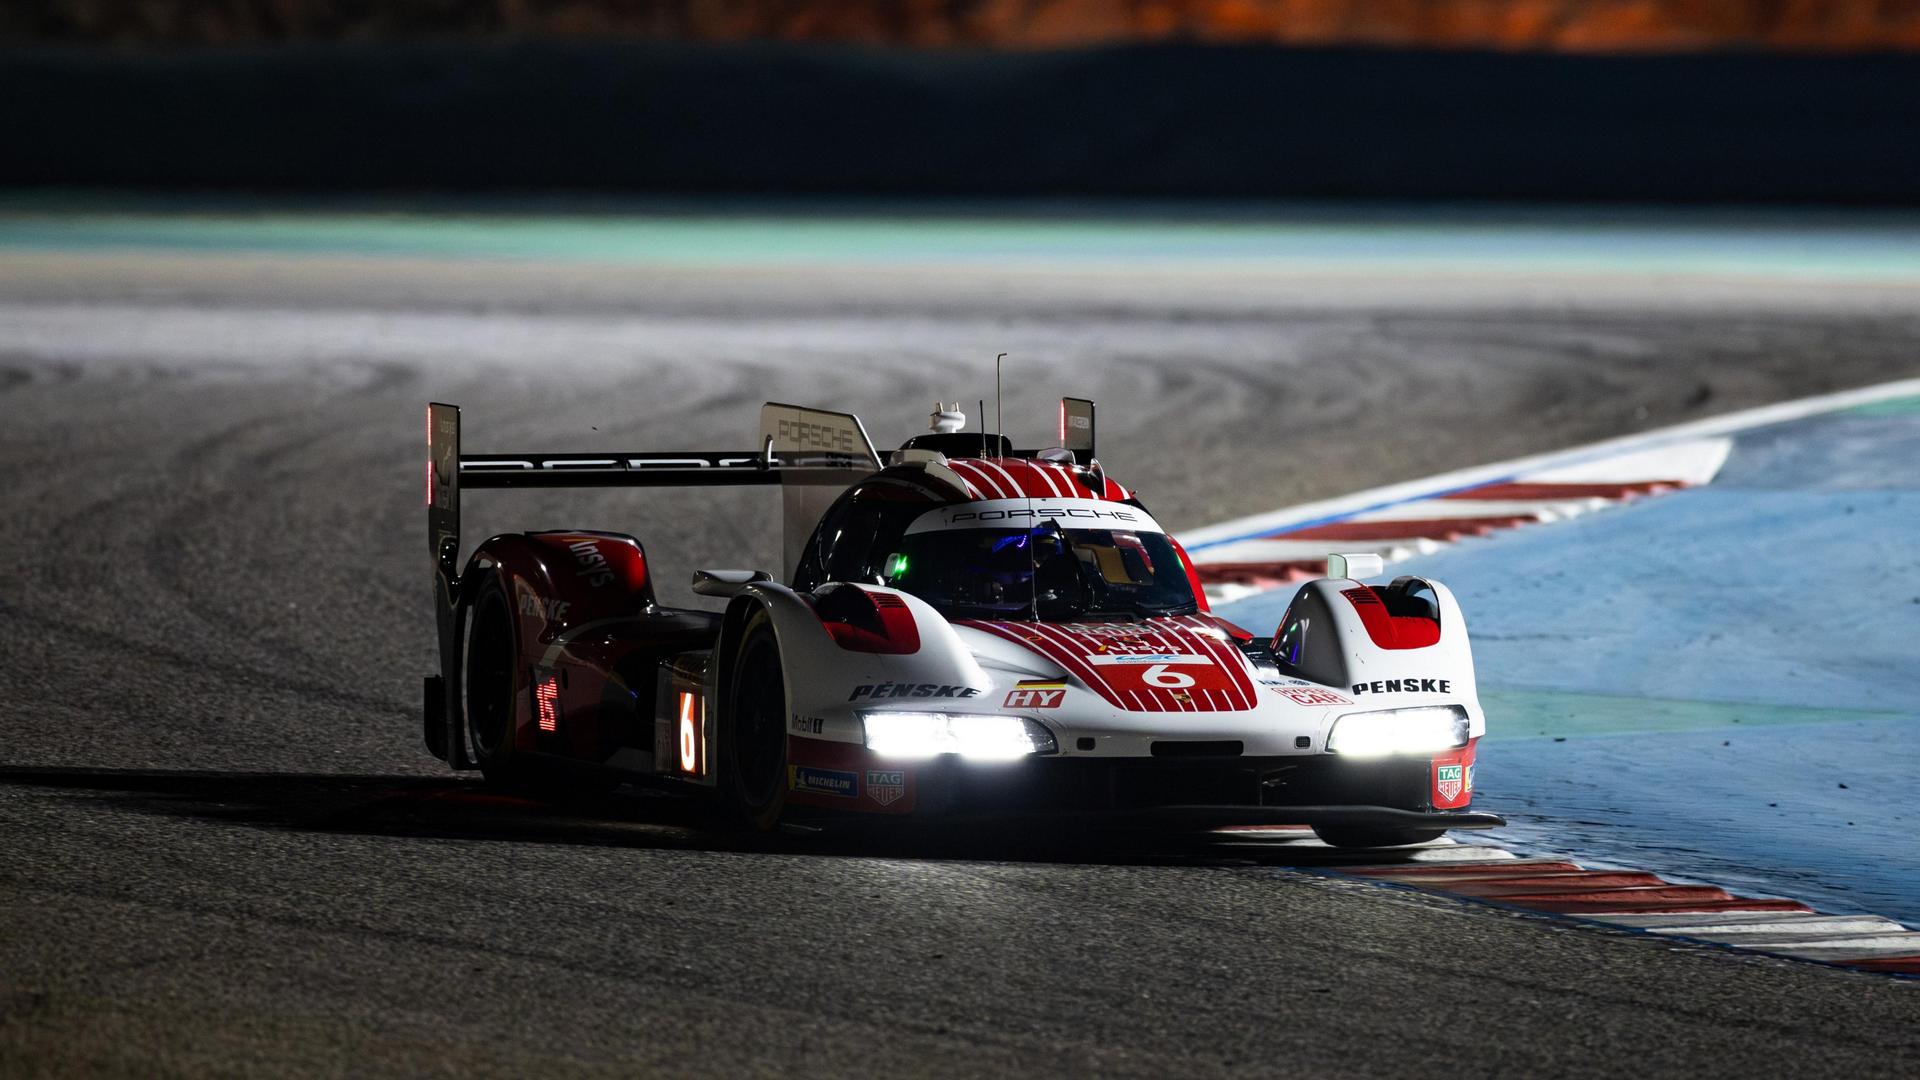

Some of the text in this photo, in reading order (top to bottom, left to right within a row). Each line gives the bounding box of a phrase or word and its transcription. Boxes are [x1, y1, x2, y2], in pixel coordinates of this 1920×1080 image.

[779, 419, 853, 452] PORSCHE
[952, 508, 1138, 523] PORSCHE
[1141, 664, 1196, 689] 6
[848, 681, 981, 702] PENSKE
[1352, 678, 1451, 695] PENSKE
[1007, 690, 1063, 707] HY
[1291, 694, 1347, 704] CAR
[680, 692, 696, 771] 6
[791, 713, 813, 733] Mobil
[807, 774, 851, 790] MICHELIN
[871, 772, 901, 785] TAG
[1440, 768, 1461, 780] TAG
[868, 785, 902, 803] HEUER
[1439, 781, 1461, 798] HEUER
